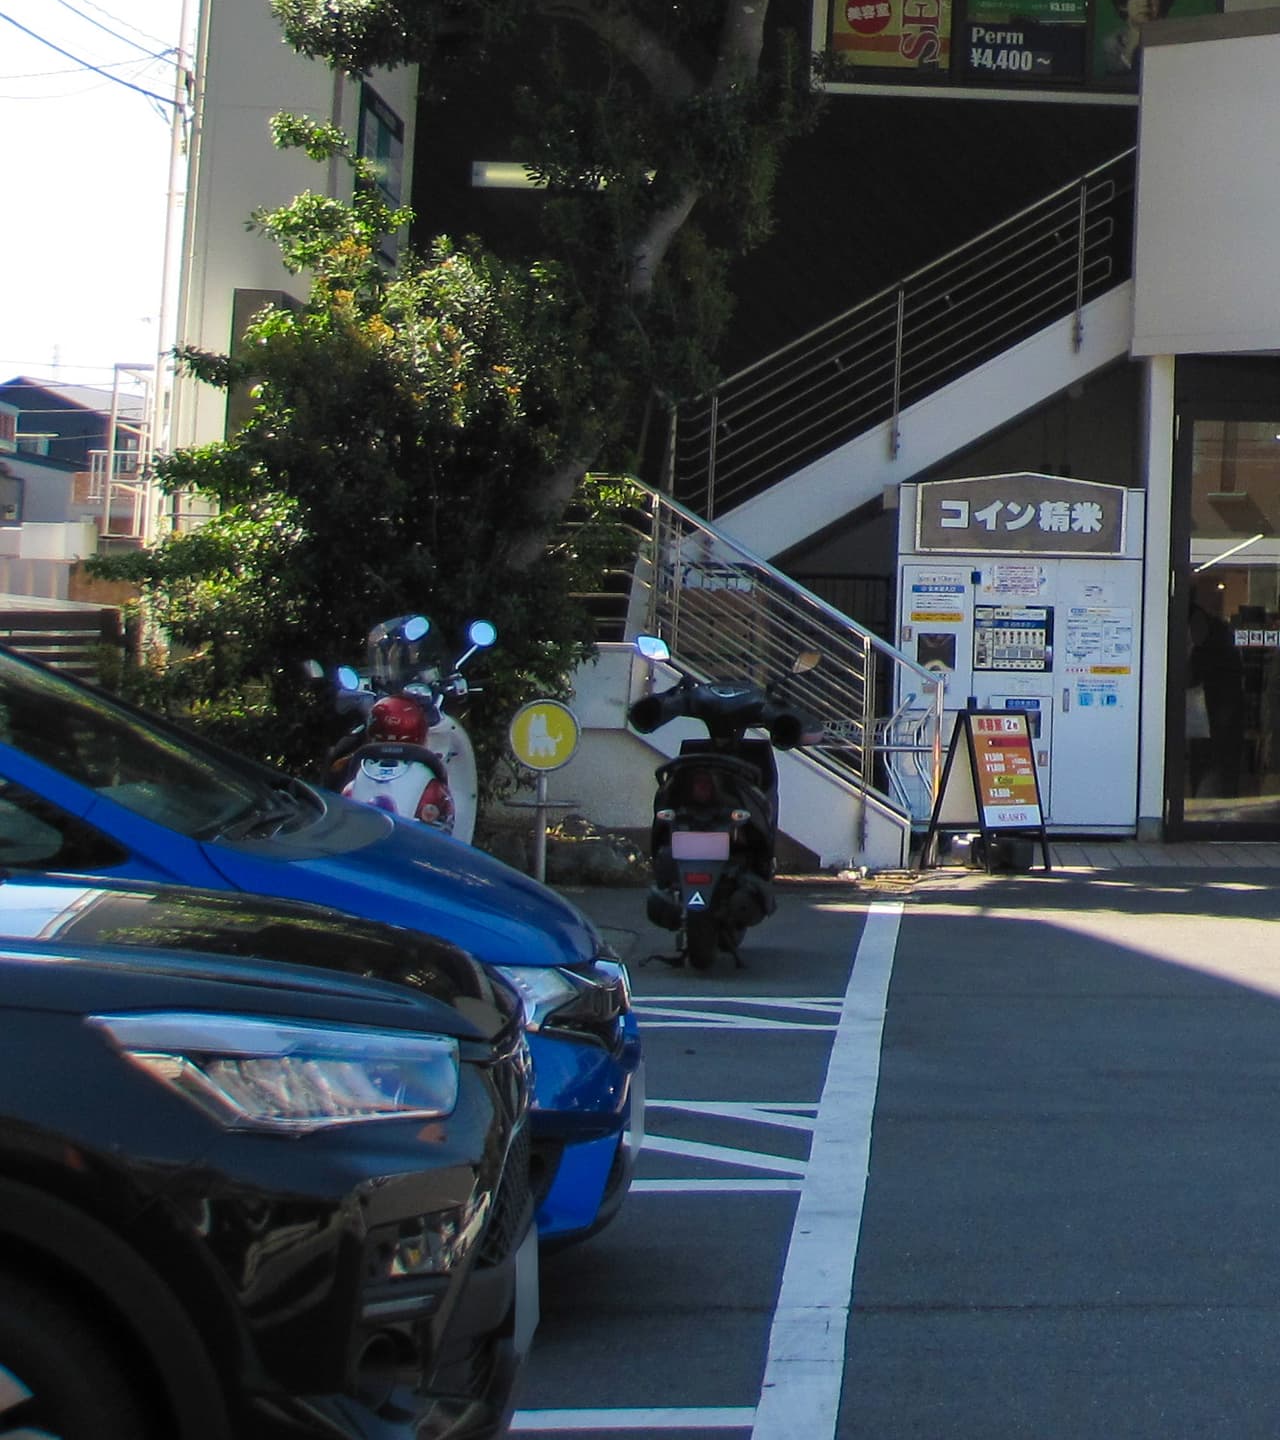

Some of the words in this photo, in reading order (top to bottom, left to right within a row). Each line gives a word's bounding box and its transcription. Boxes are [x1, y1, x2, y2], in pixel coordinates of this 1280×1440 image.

[846, 0, 892, 23] 美容室
[971, 26, 1025, 46] Perm
[940, 499, 1102, 533] コイン精米
